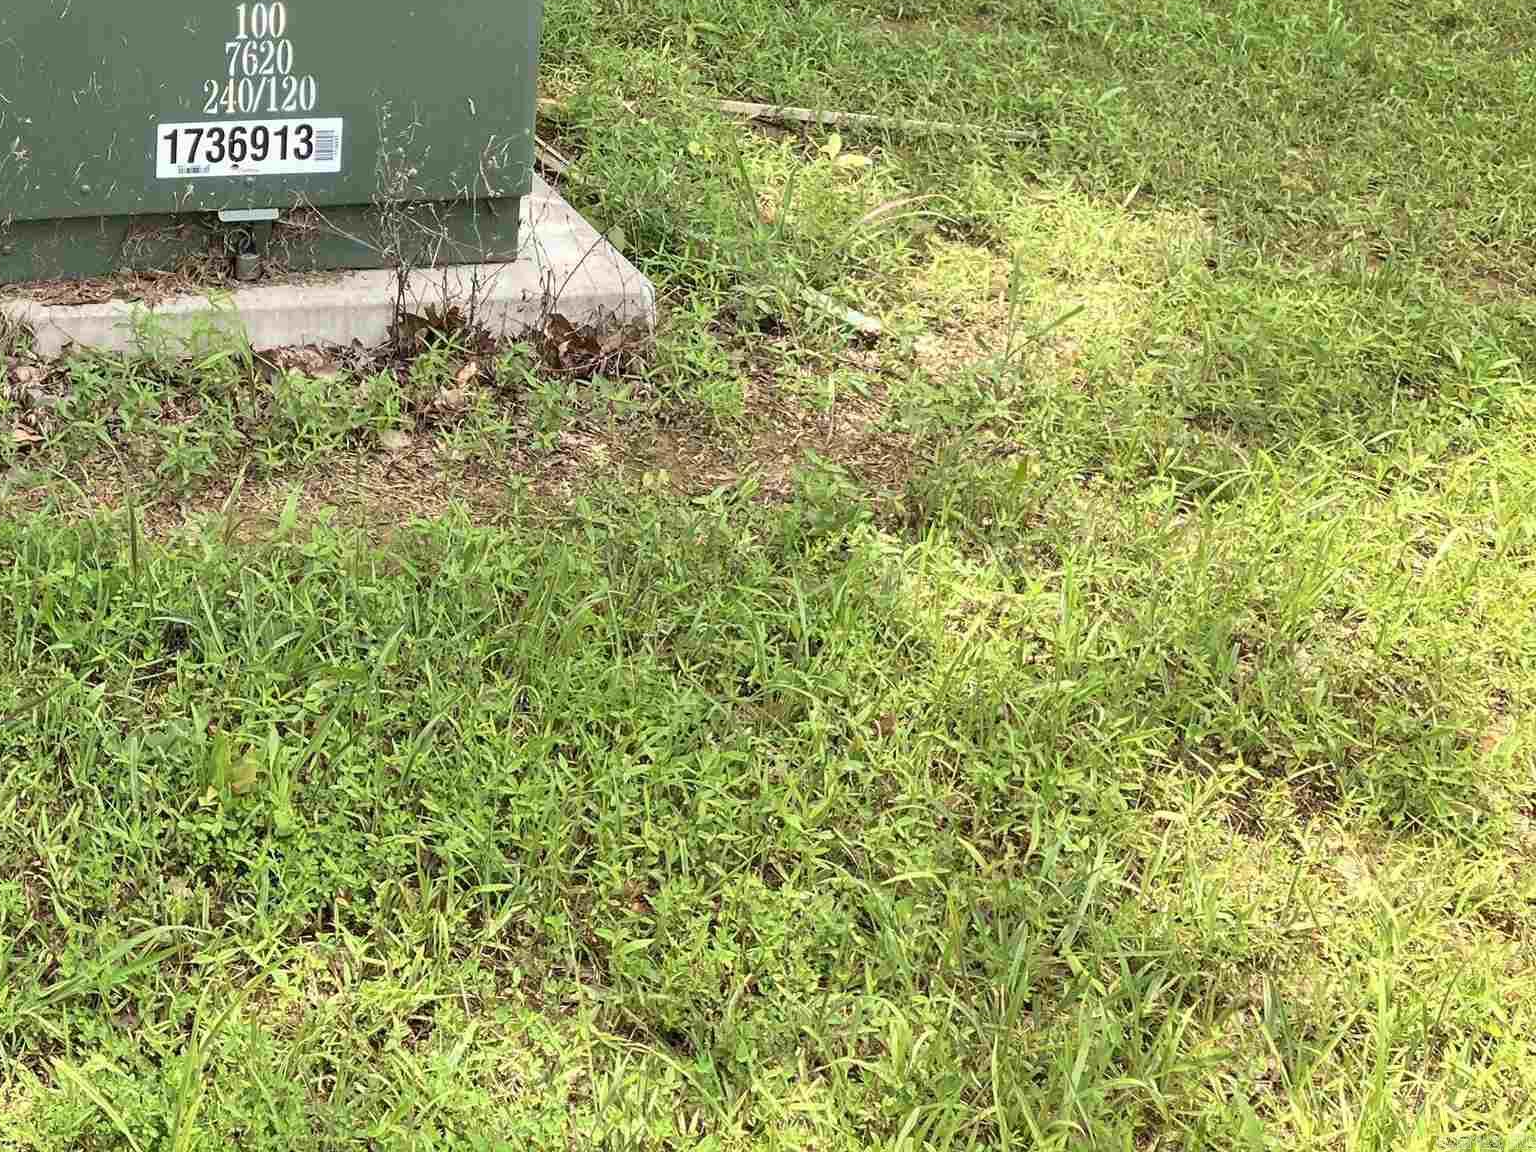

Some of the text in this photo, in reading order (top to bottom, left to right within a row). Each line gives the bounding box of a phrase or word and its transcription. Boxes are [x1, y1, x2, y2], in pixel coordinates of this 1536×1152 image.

[235, 1, 287, 40] 100
[225, 39, 294, 77] 7620
[202, 75, 317, 115] 240/120
[163, 124, 315, 165] 1736913
